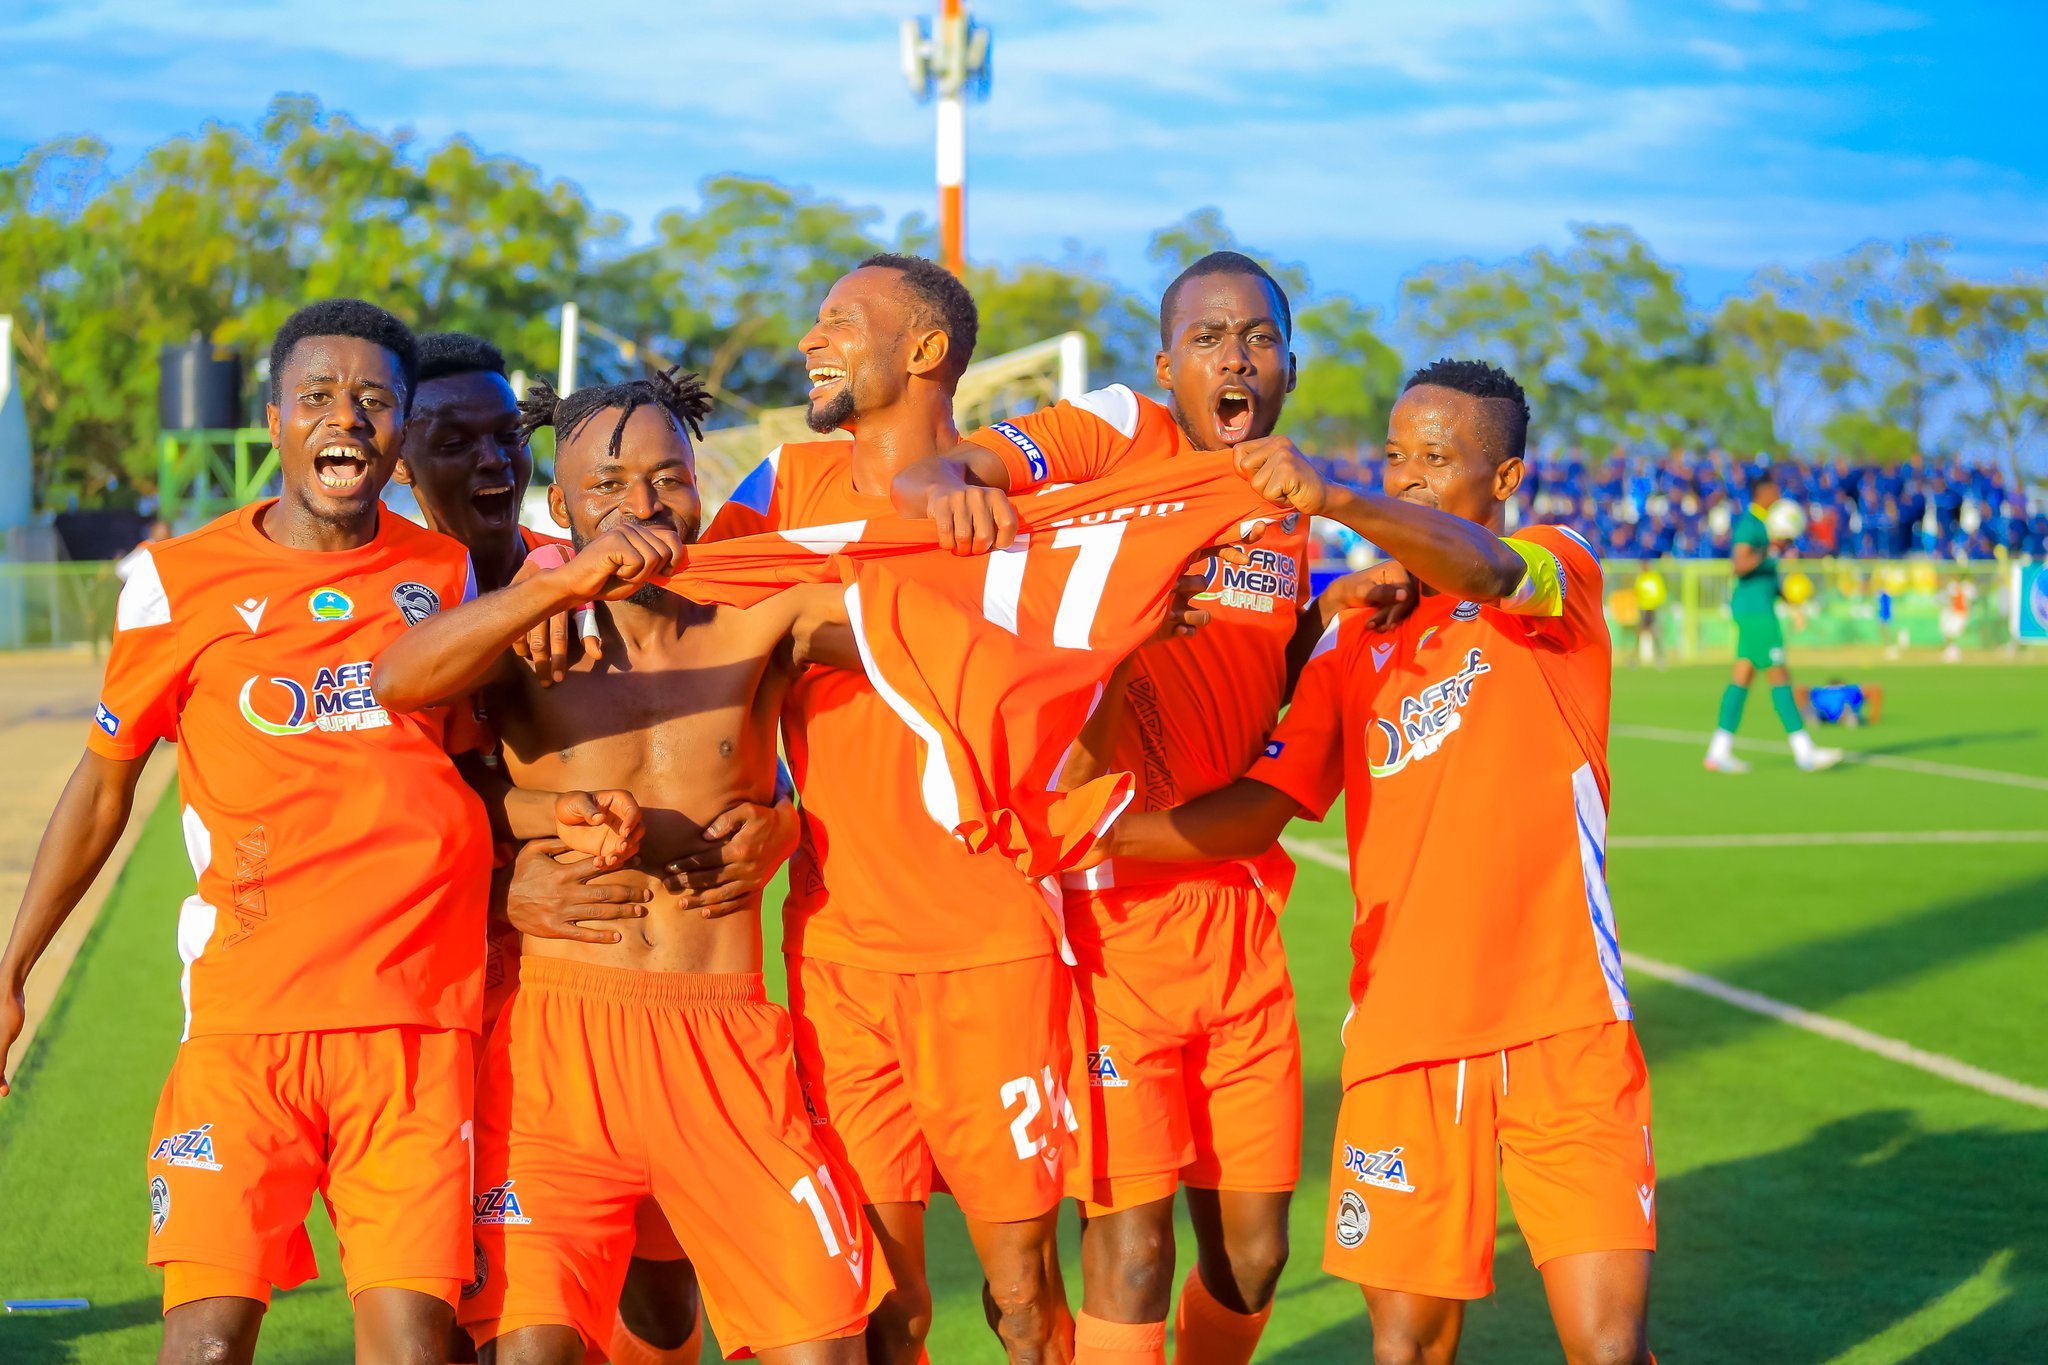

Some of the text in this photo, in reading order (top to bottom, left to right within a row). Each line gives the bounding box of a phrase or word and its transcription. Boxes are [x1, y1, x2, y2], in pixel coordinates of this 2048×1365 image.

[1223, 567, 1298, 603] MEDICA
[1220, 589, 1274, 613] SUPPLIER
[316, 710, 392, 732] SUPPLIER
